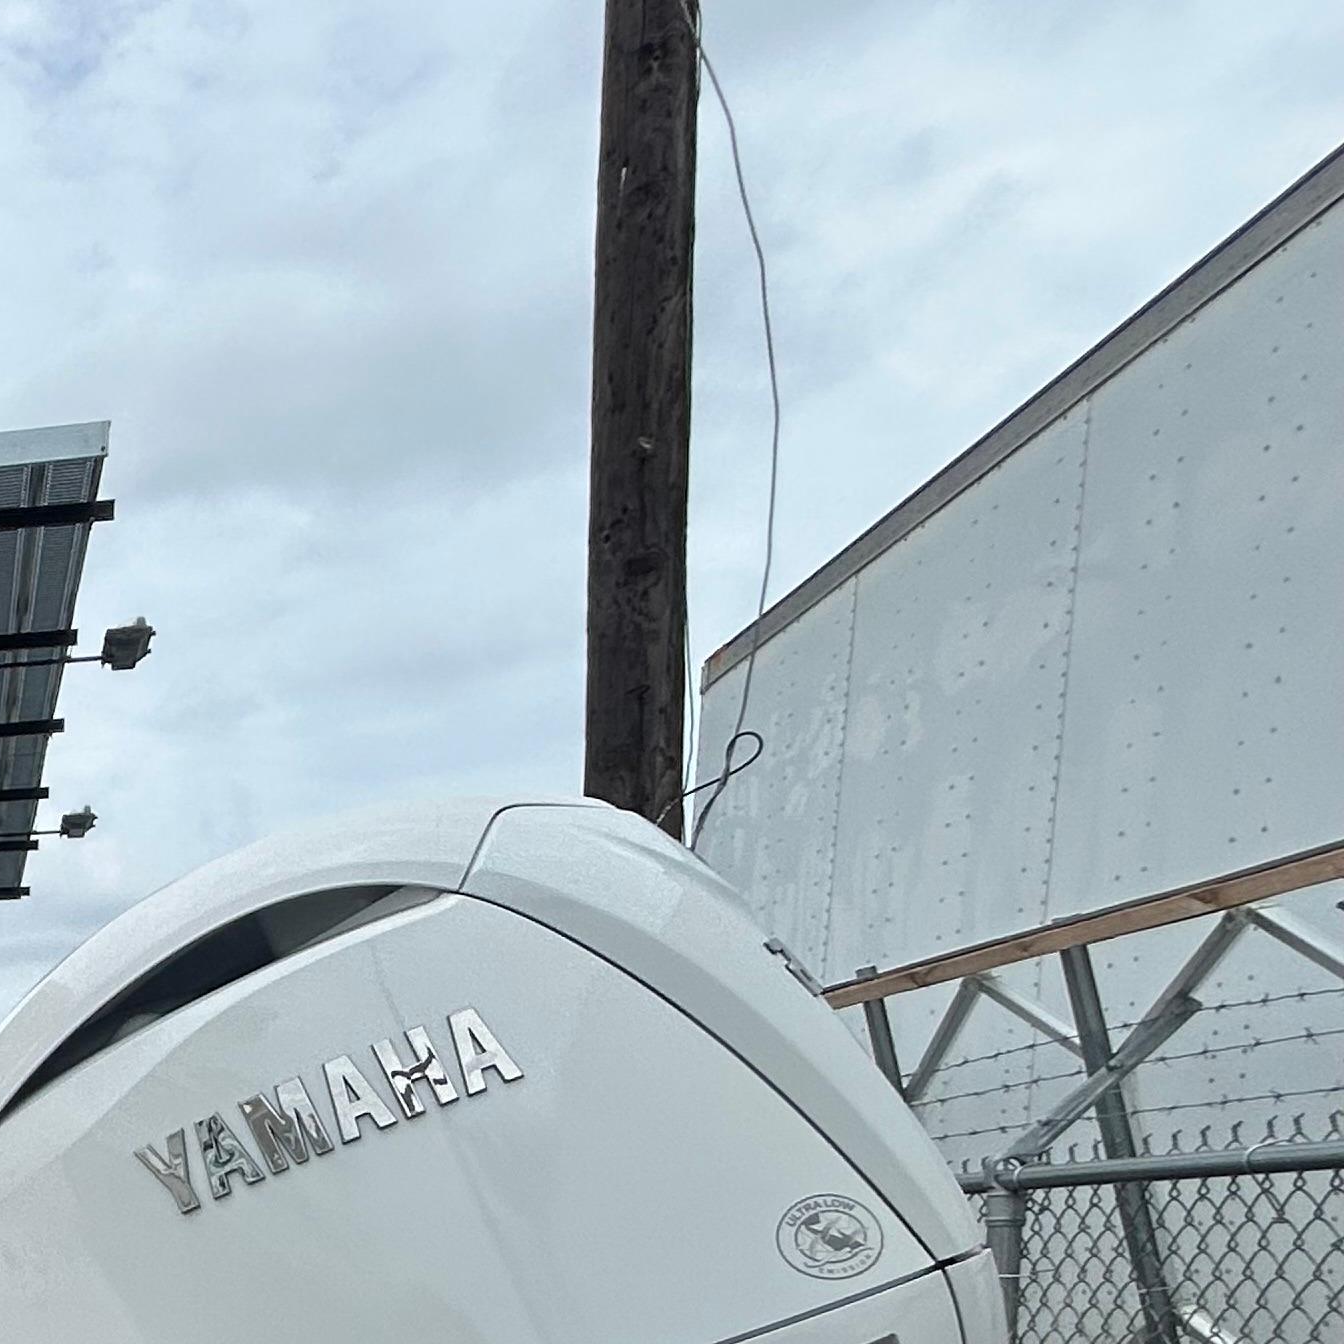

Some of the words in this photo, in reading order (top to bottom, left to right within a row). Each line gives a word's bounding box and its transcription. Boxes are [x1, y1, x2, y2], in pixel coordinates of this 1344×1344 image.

[133, 1006, 524, 1215] YAMAHA
[785, 1200, 823, 1227] ULTRA
[823, 1199, 856, 1212] LOW
